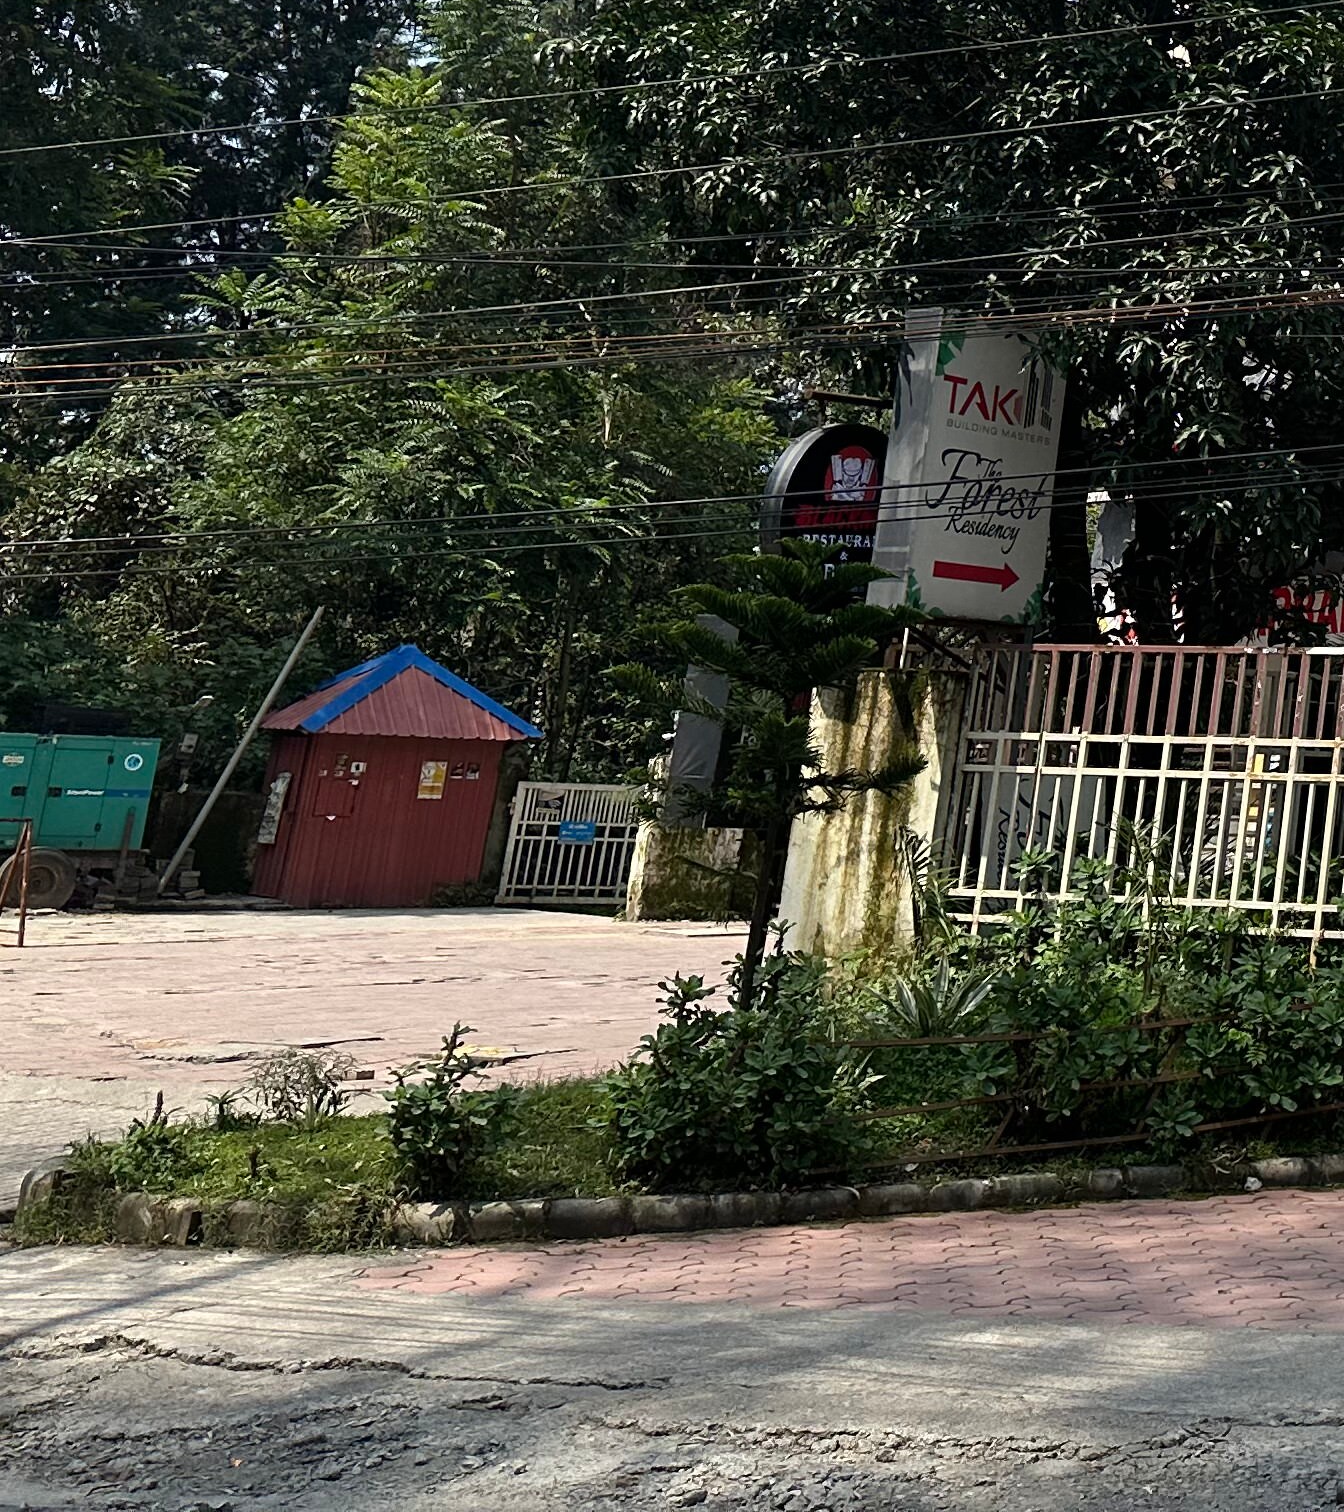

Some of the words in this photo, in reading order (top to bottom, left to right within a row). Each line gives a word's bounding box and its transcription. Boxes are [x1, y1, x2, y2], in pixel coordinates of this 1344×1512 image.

[944, 374, 1019, 425] TAK
[946, 418, 997, 436] BUILDING
[1001, 428, 1050, 446] MASTERS
[925, 448, 1049, 520] Forest
[979, 459, 1003, 483] The
[944, 506, 1021, 554] Residency
